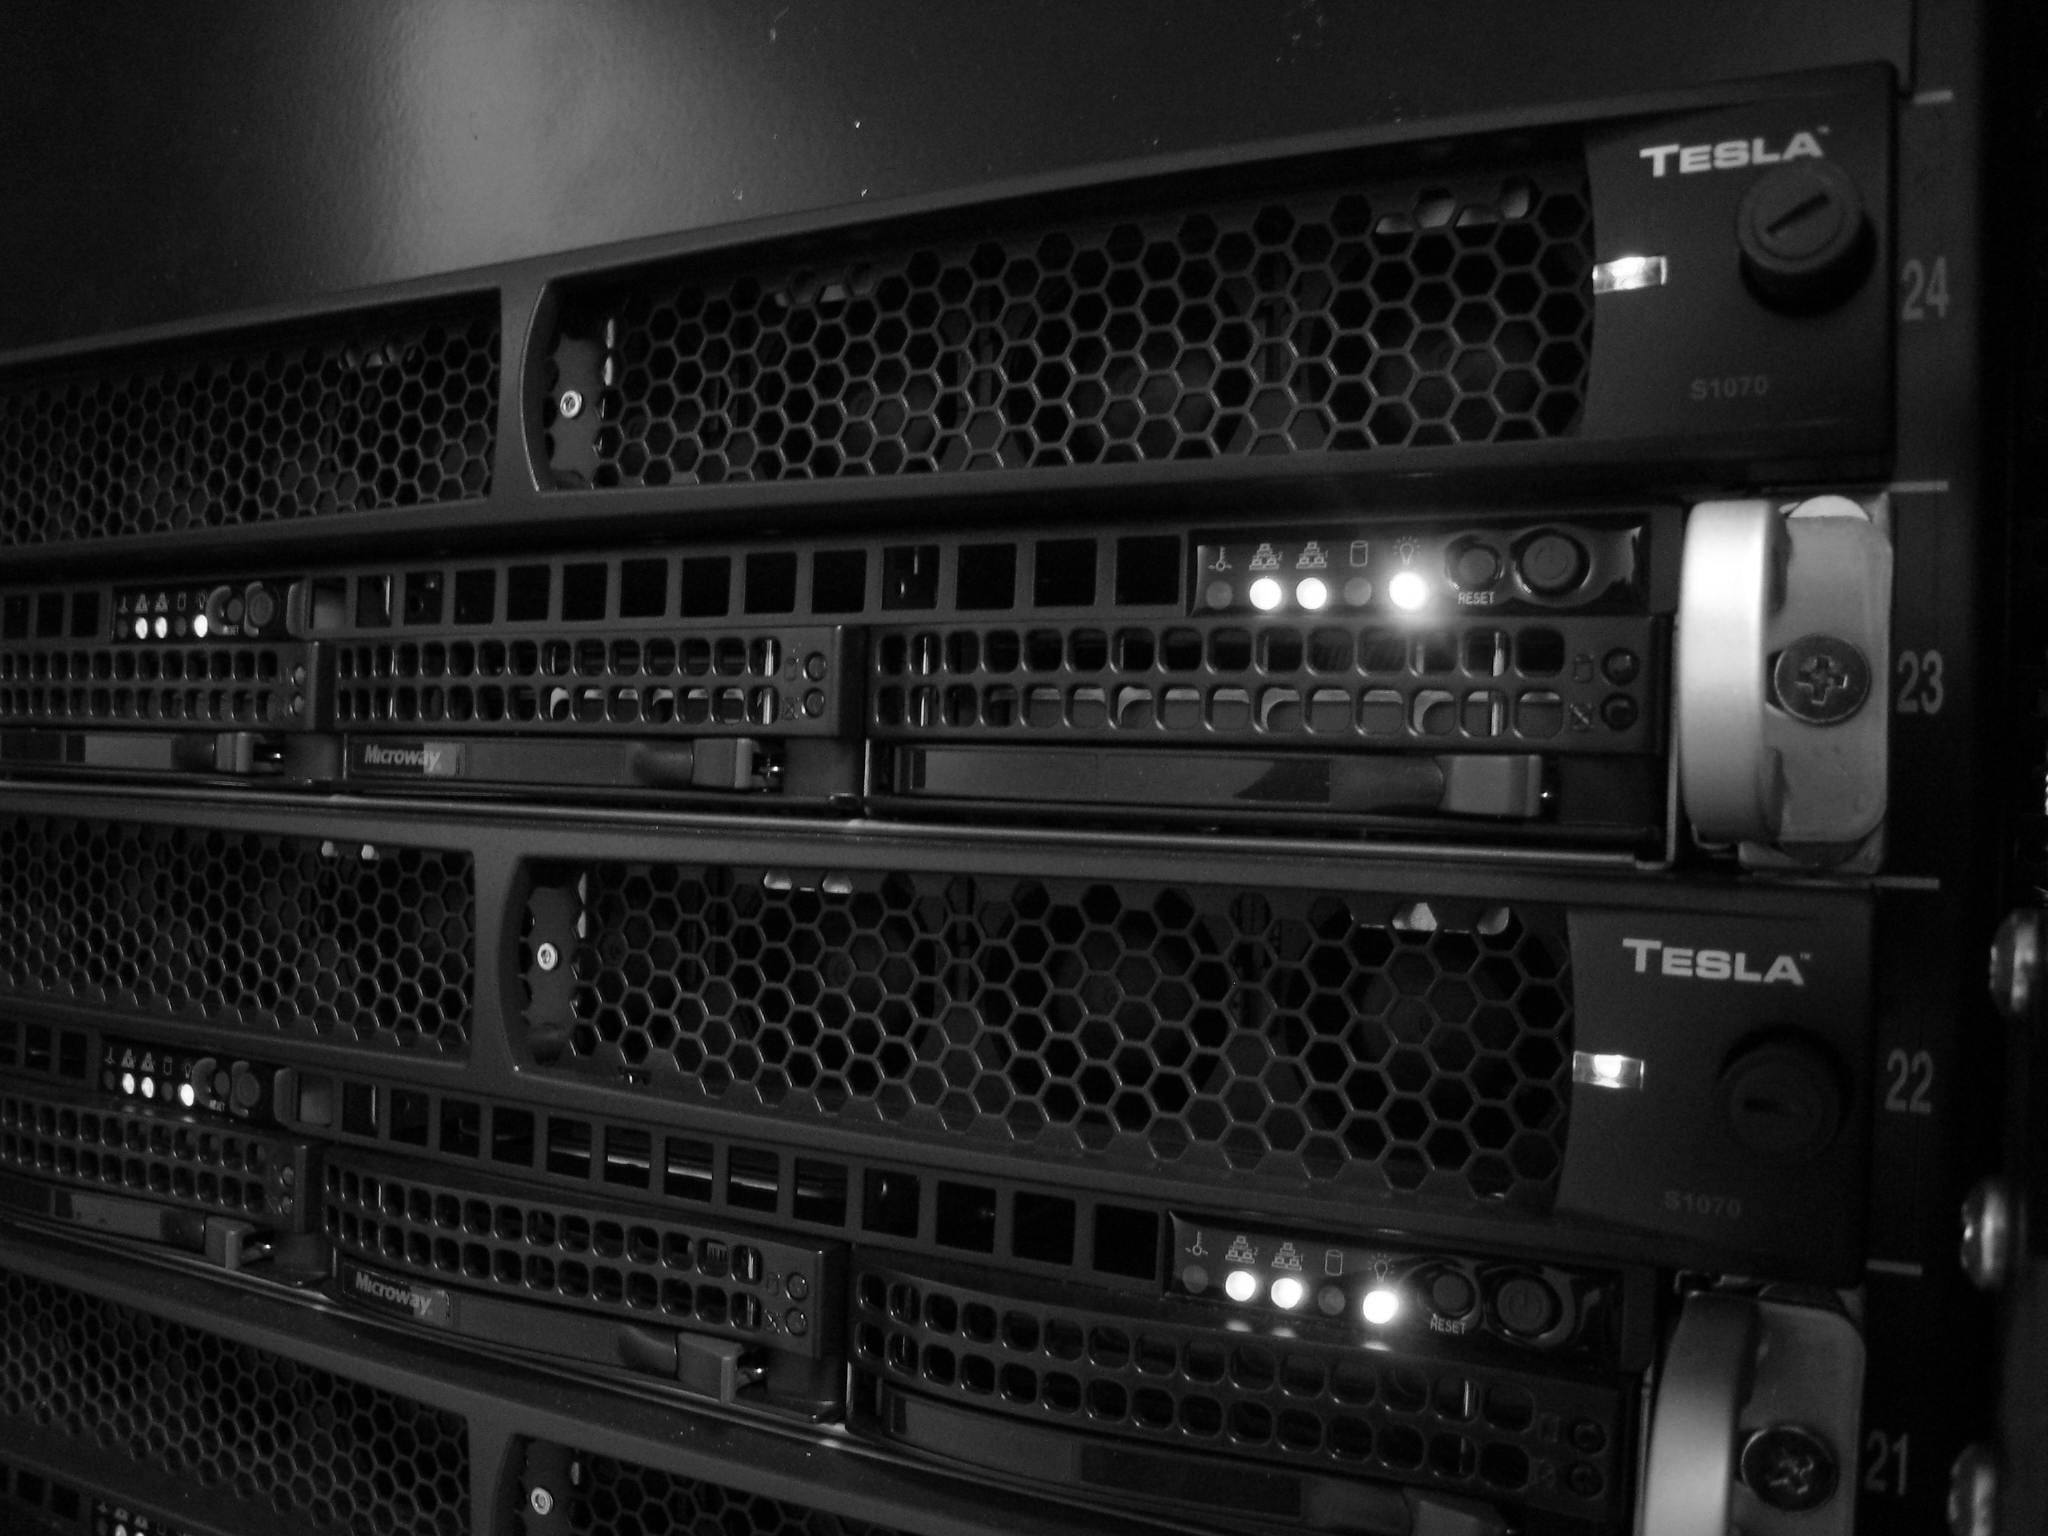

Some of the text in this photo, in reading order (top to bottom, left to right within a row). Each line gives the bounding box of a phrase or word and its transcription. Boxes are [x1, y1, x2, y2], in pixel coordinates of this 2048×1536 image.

[1638, 131, 1824, 178] TESLA
[1901, 256, 1950, 321] 24
[1689, 376, 1770, 400] S1070
[1457, 590, 1495, 606] RESET
[1897, 649, 1944, 715] 23
[364, 743, 442, 773] Microway
[1621, 938, 1806, 986] TESLA
[1884, 1048, 1935, 1115] 22
[355, 1271, 432, 1316] Microway
[1429, 1314, 1466, 1336] RESET
[1864, 1428, 1910, 1496] 21
